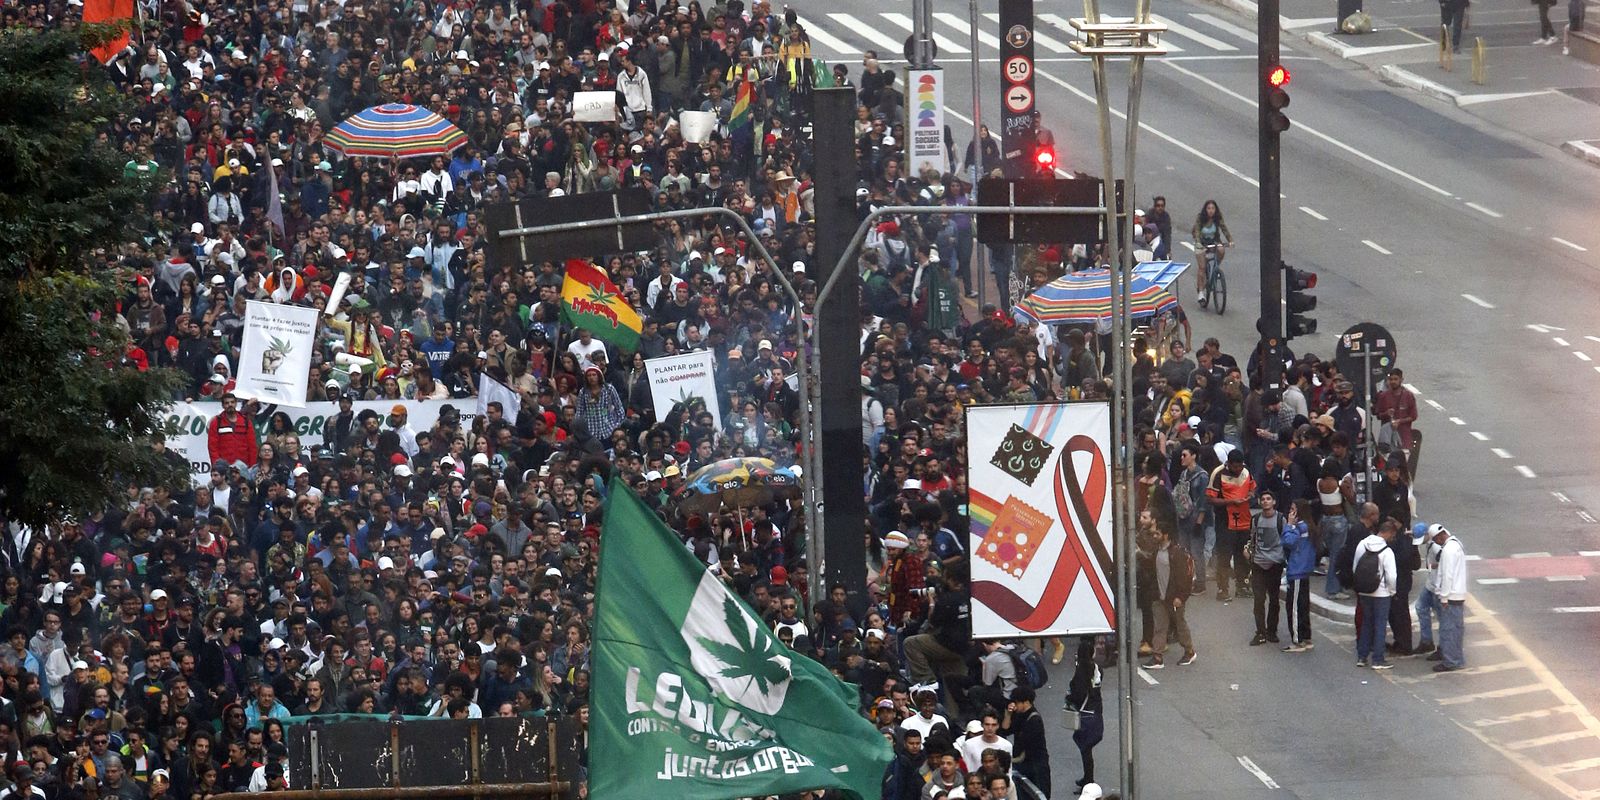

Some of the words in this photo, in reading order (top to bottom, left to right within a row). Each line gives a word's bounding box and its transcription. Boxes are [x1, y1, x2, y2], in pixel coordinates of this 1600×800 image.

[1009, 62, 1028, 75] 50
[428, 351, 450, 361] VANS
[654, 363, 687, 374] PLANTAR
[688, 362, 704, 370] para
[773, 475, 785, 483] elo
[723, 480, 738, 489] elo
